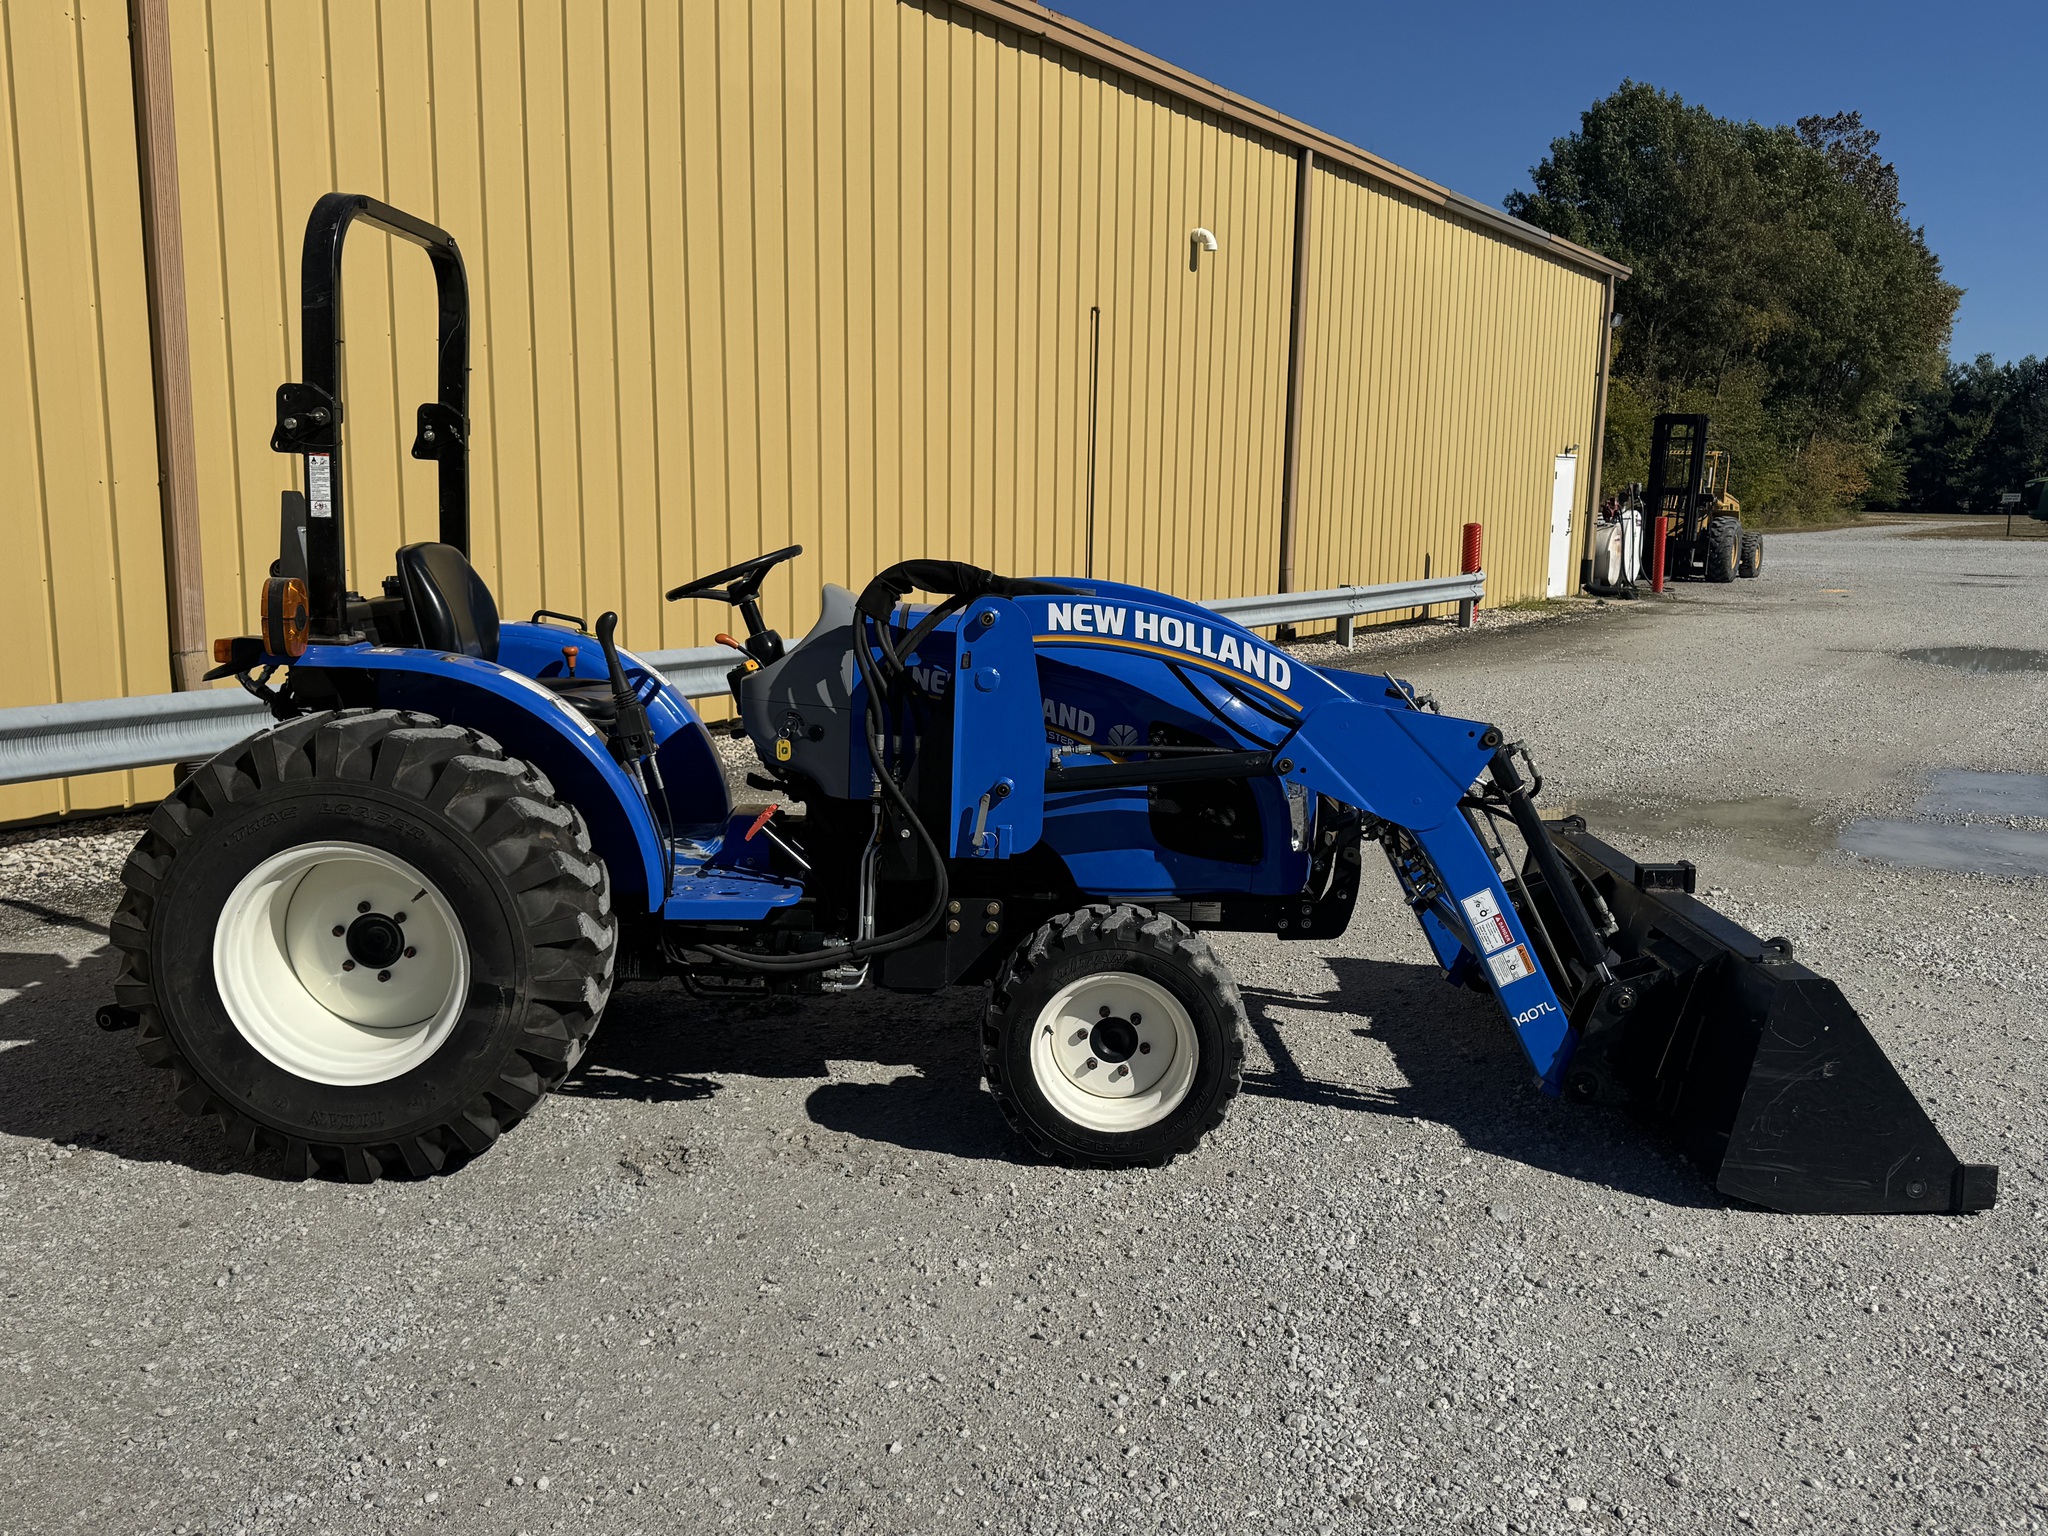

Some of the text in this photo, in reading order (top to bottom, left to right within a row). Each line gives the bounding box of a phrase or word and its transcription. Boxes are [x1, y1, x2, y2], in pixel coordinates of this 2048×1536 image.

[1048, 602, 1292, 691] NEW HOLLAND
[912, 666, 951, 694] NE
[1043, 698, 1095, 737] AND
[1048, 731, 1075, 748] STER
[317, 801, 429, 842] LOADER
[1498, 920, 1513, 943] DANGER
[1511, 1001, 1557, 1027] 140TL
